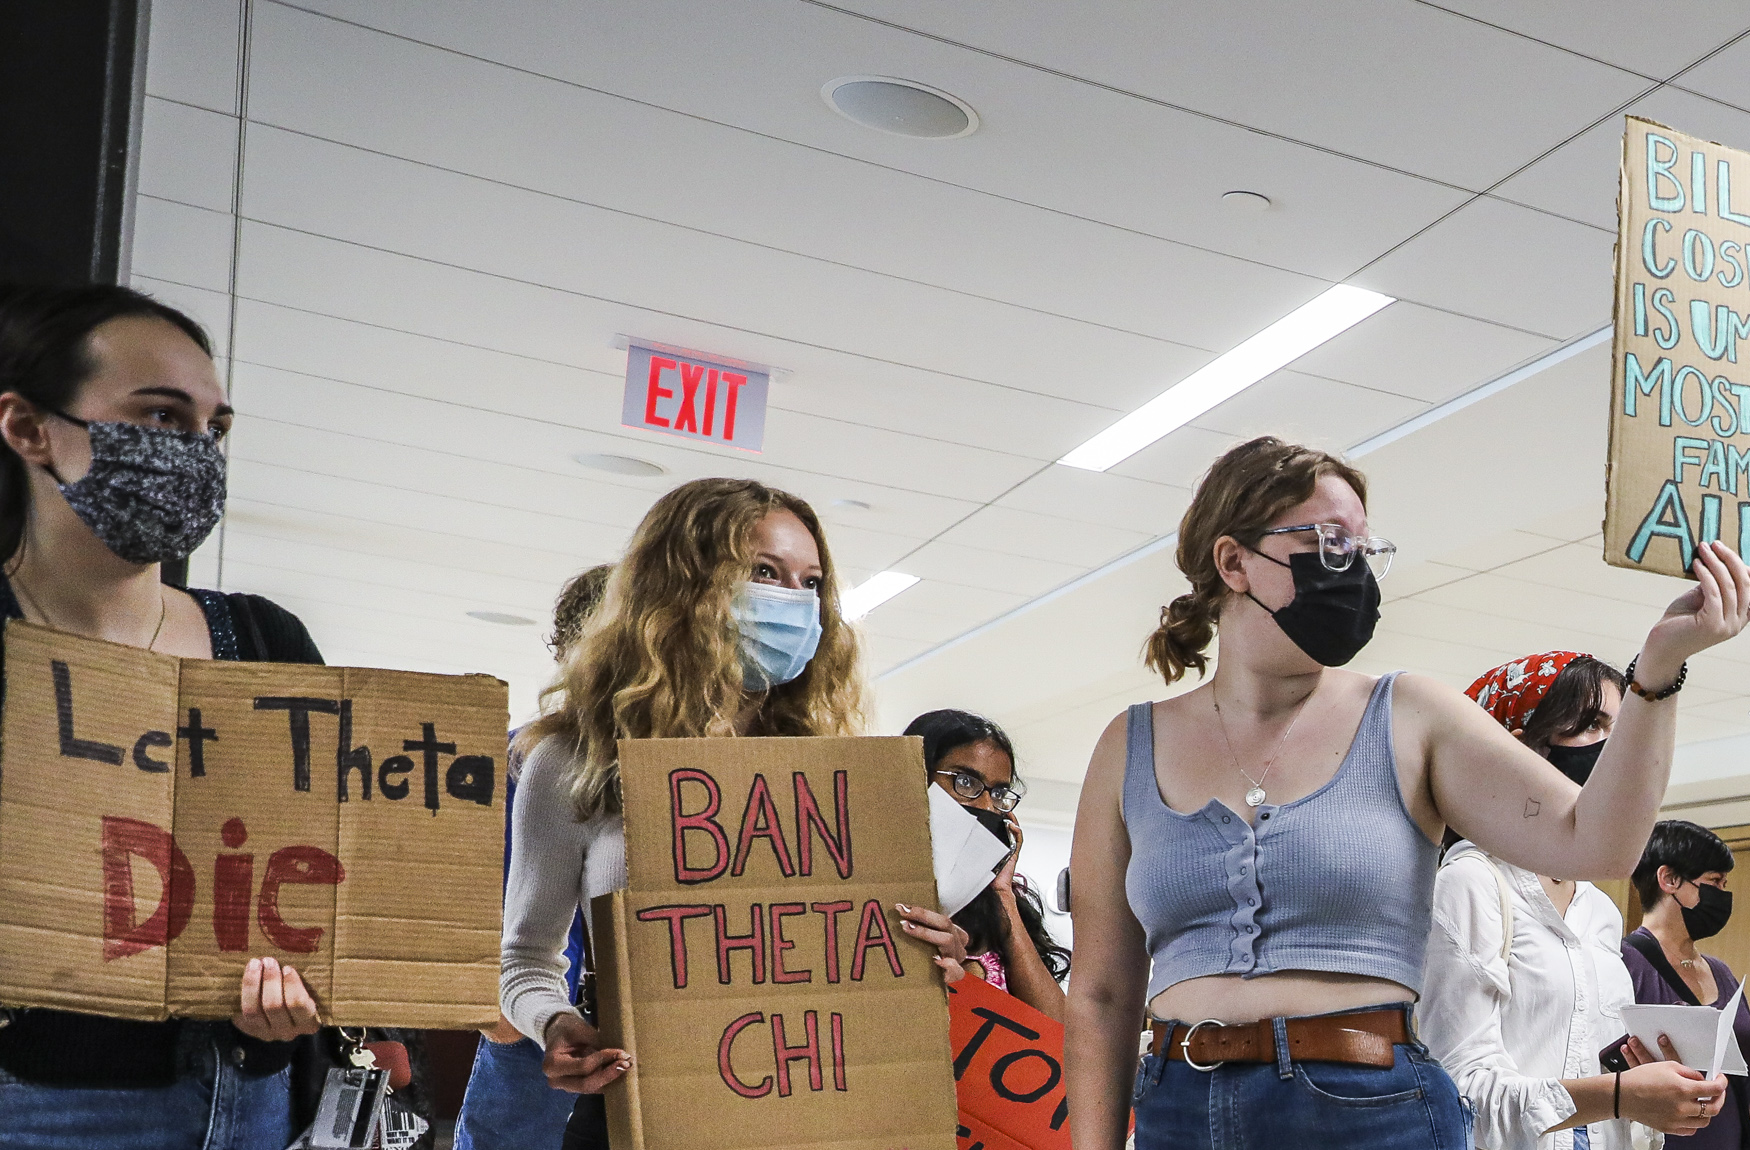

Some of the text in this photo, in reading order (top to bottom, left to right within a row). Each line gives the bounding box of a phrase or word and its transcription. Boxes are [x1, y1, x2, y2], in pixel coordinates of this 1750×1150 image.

[1633, 282, 1681, 350] IS
[643, 355, 747, 441] EXIT
[51, 660, 496, 817] Let Theta
[668, 768, 853, 884] BAN
[101, 816, 346, 963] Die
[635, 899, 906, 989] THETA
[717, 1009, 848, 1099] CHI
